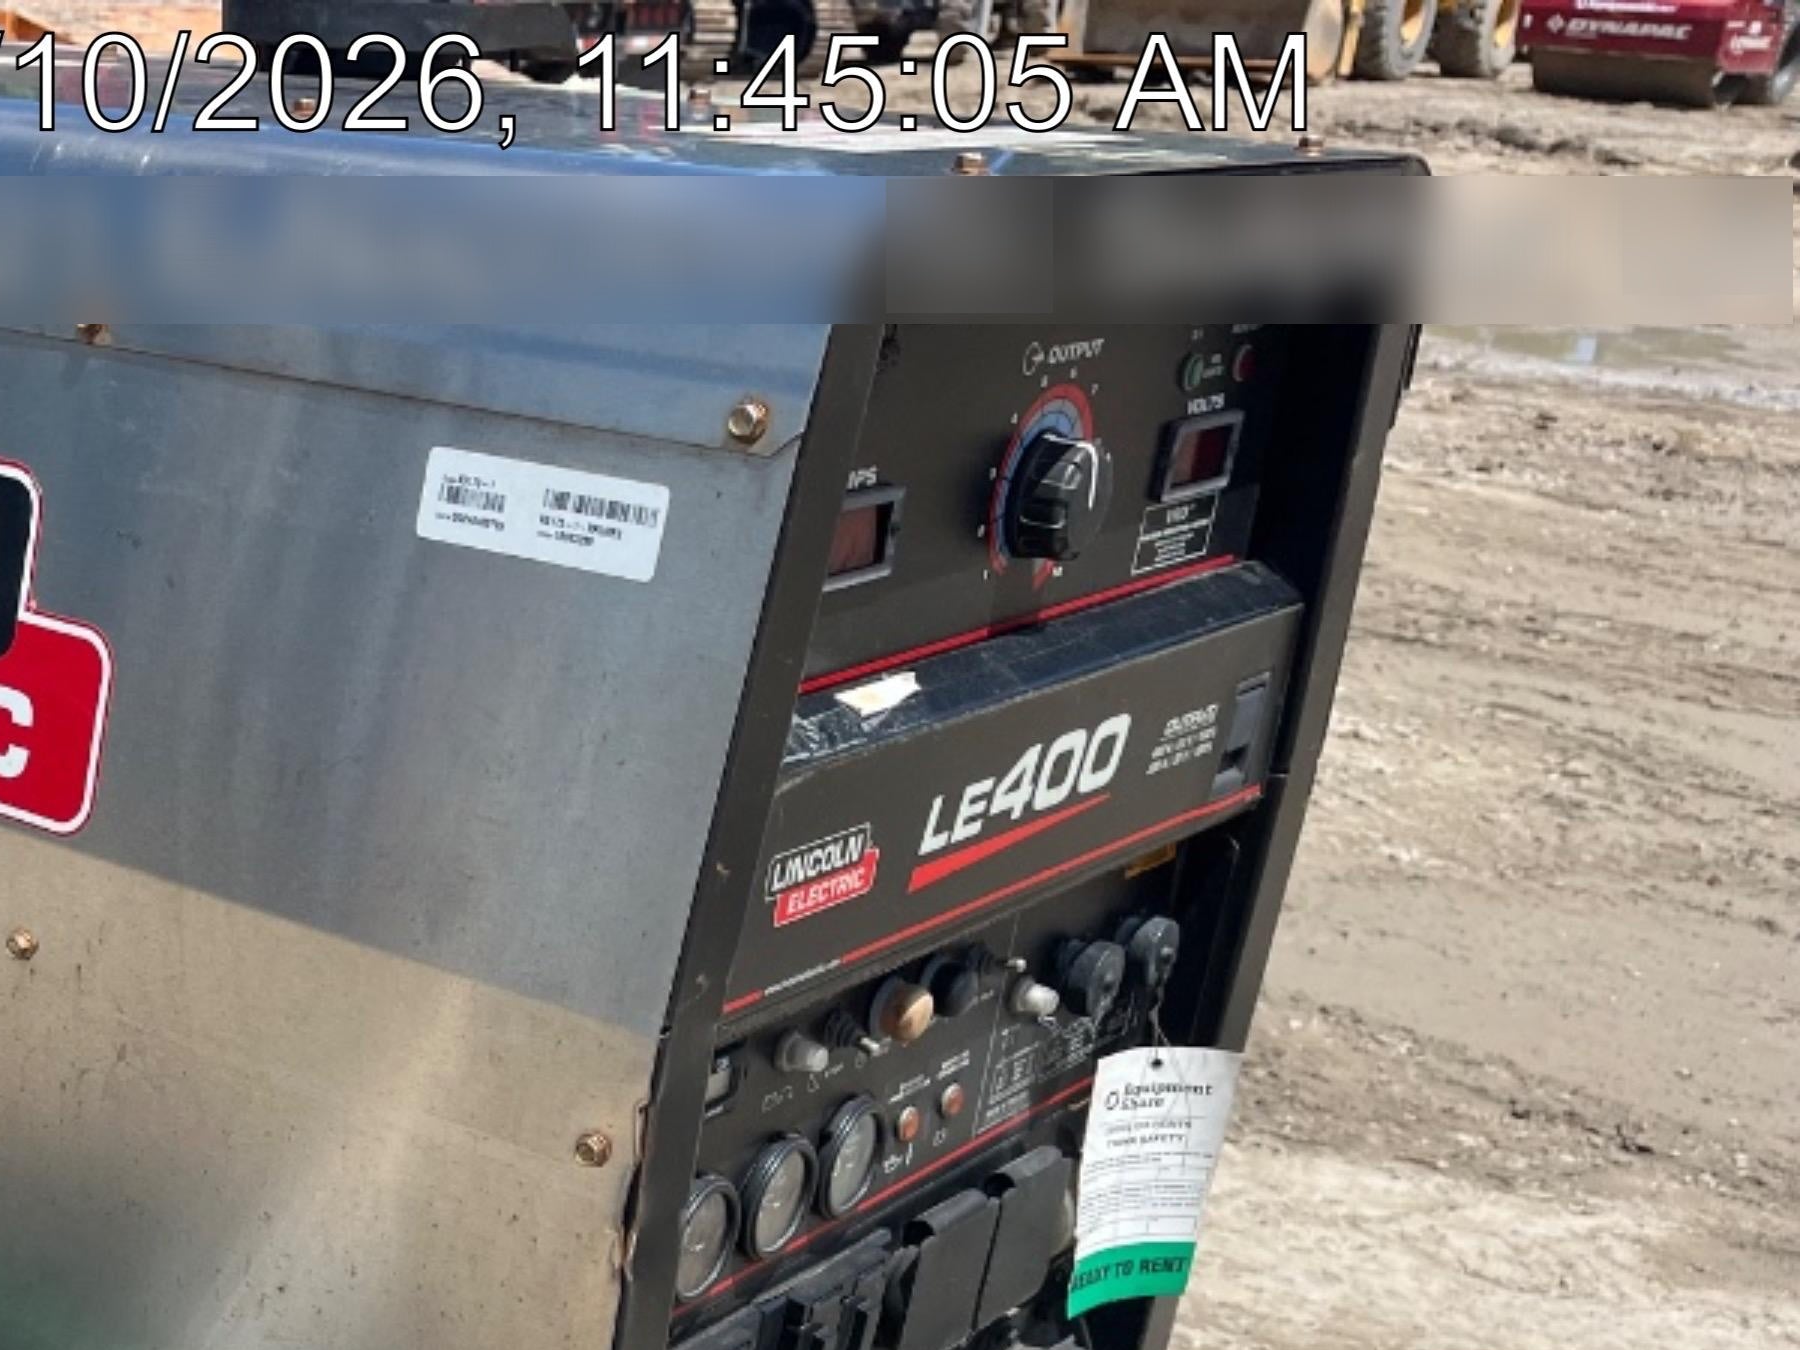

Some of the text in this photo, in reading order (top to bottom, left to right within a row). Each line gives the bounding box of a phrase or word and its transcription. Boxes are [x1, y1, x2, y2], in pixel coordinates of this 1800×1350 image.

[917, 712, 1132, 857] LE400
[771, 833, 865, 893] LINCOLN
[786, 866, 866, 915] ELECTRIC
